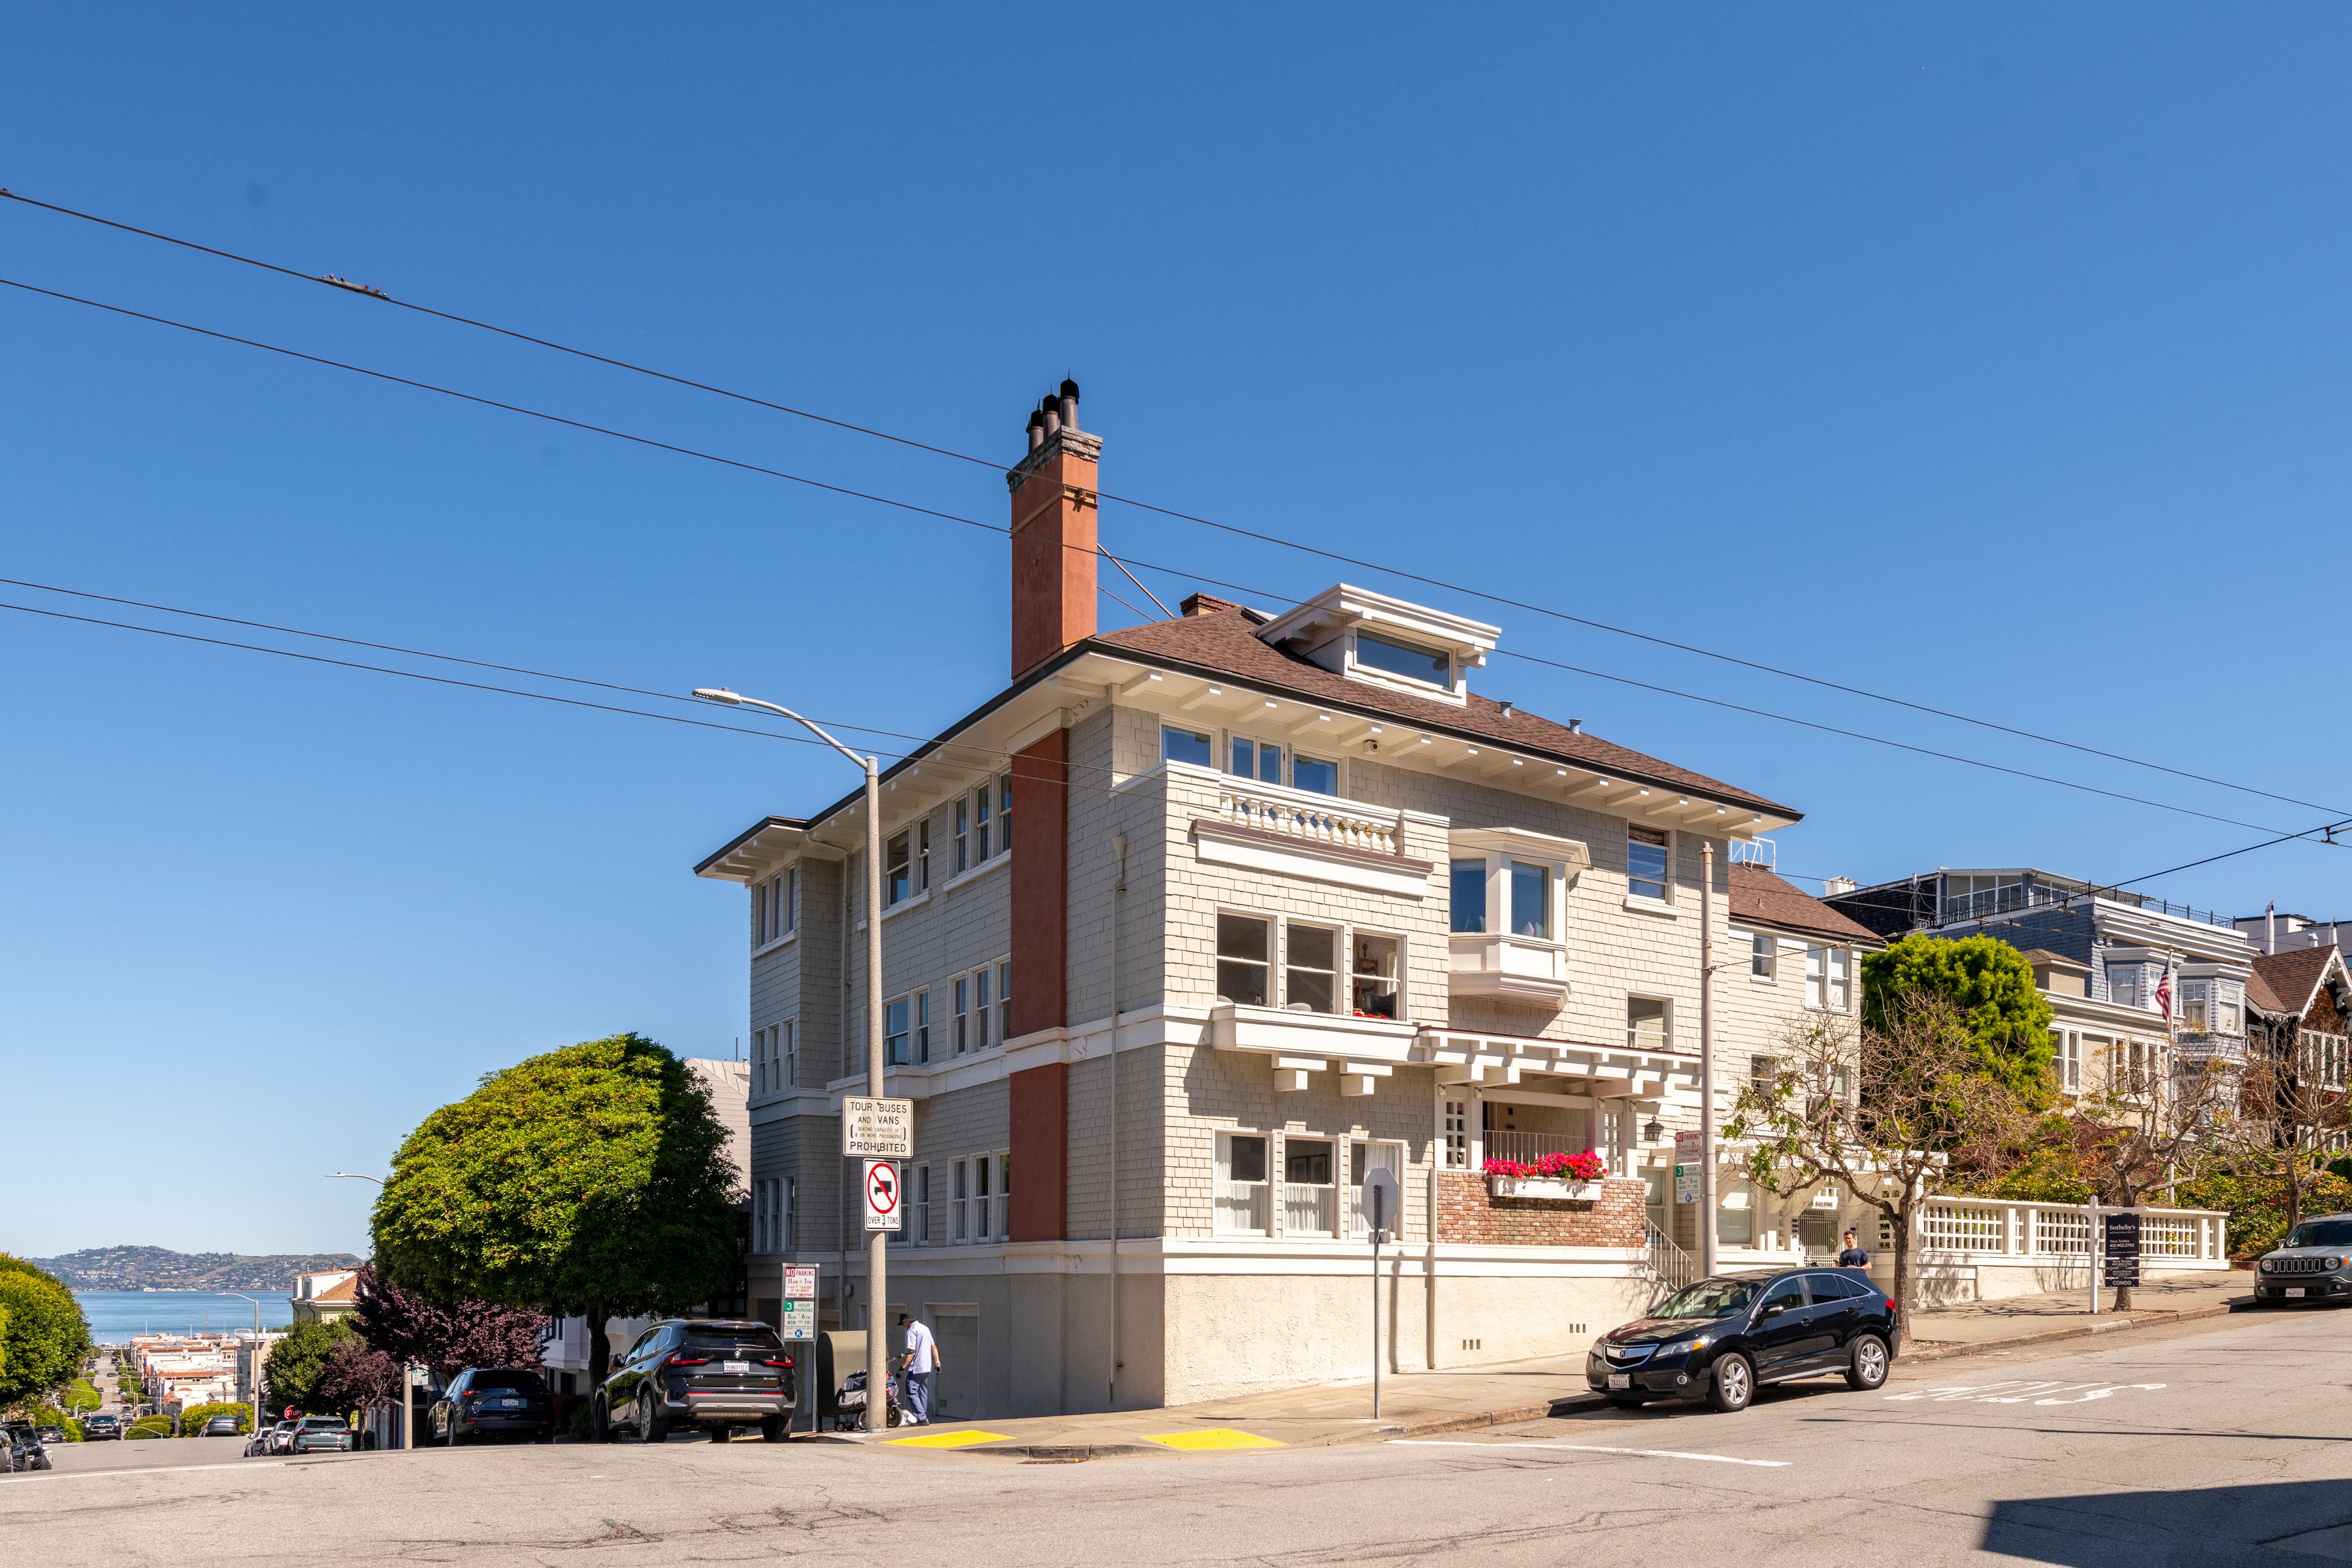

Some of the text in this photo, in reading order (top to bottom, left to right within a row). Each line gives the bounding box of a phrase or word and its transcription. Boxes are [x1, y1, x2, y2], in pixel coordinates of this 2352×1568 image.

[850, 1102, 907, 1113] TOUR BUSES
[877, 1115, 900, 1125] VANS
[1676, 1133, 1683, 1142] NO
[850, 1141, 907, 1152] PROHIBITED
[1677, 1167, 1682, 1175] 3
[868, 1216, 881, 1224] OVER
[881, 1215, 886, 1224] 3
[786, 1302, 792, 1311] 3
